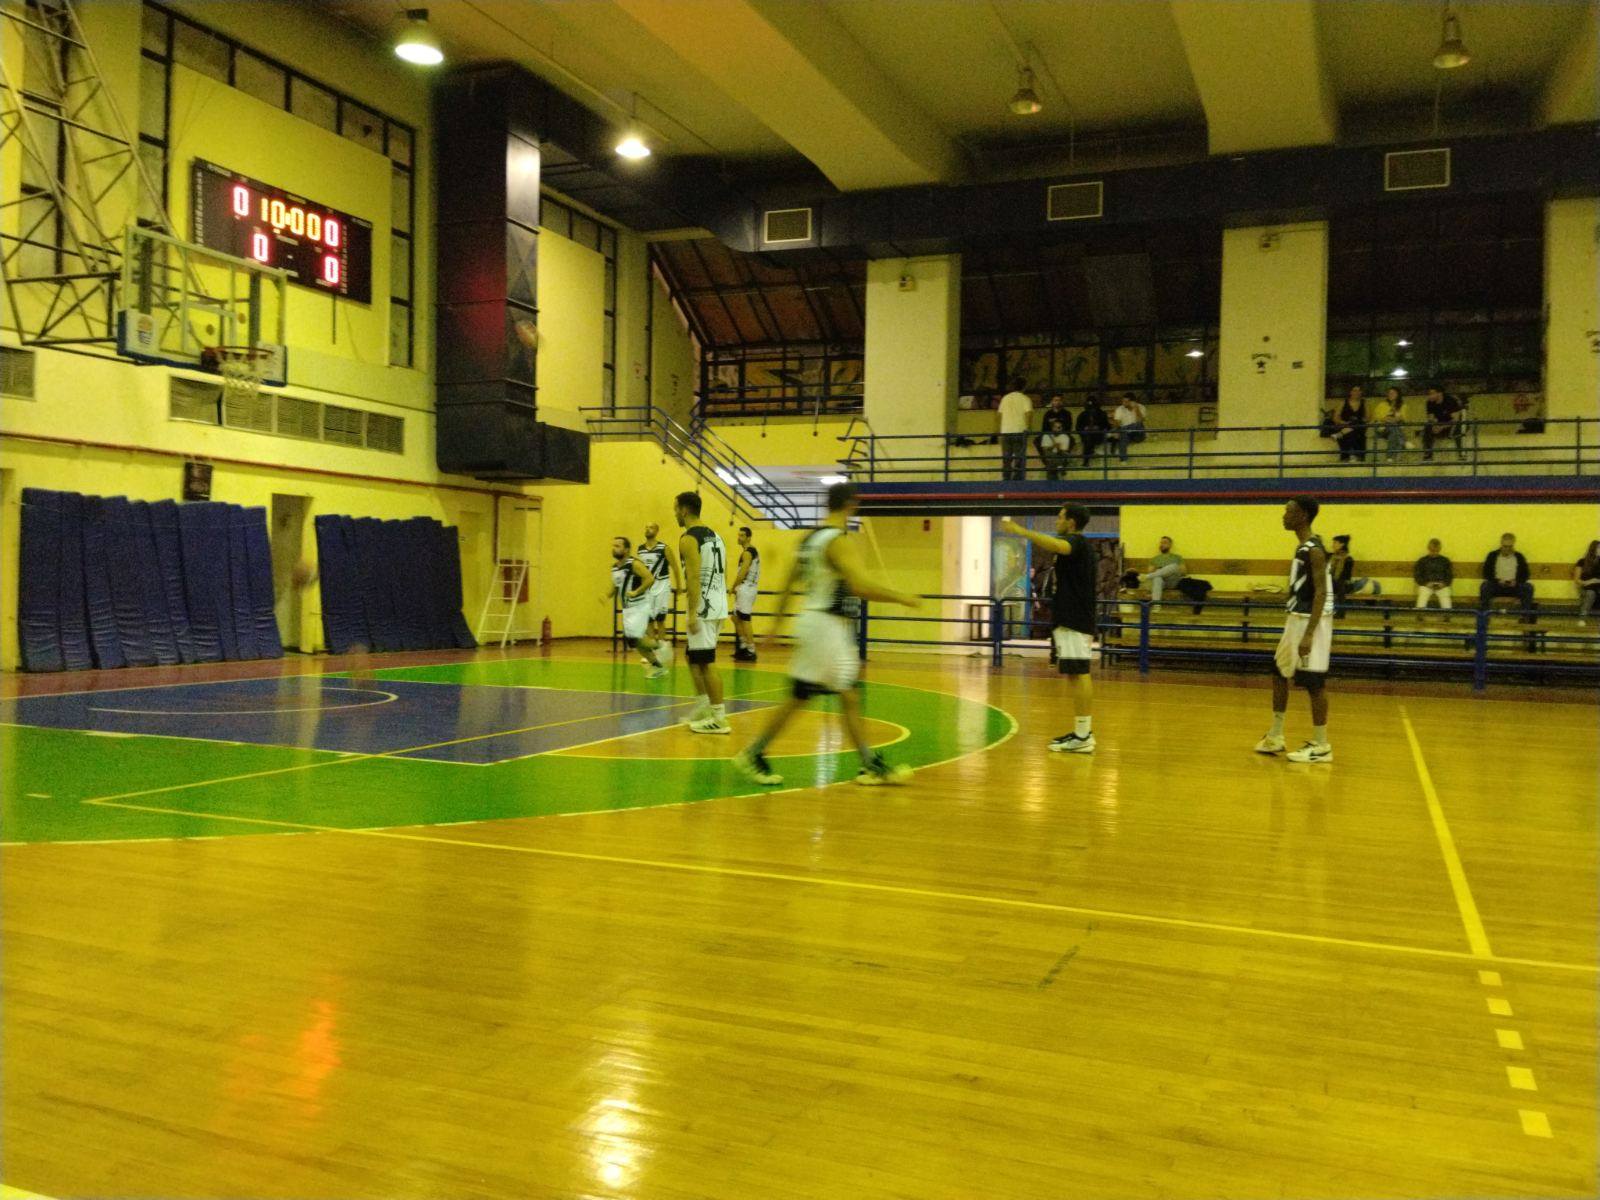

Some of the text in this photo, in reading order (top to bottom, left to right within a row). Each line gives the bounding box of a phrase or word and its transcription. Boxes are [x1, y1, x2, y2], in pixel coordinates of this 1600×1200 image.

[233, 186, 249, 216] 0
[261, 198, 321, 241] 10:00
[325, 219, 339, 247] 0
[253, 232, 268, 262] 0
[325, 256, 339, 284] 0
